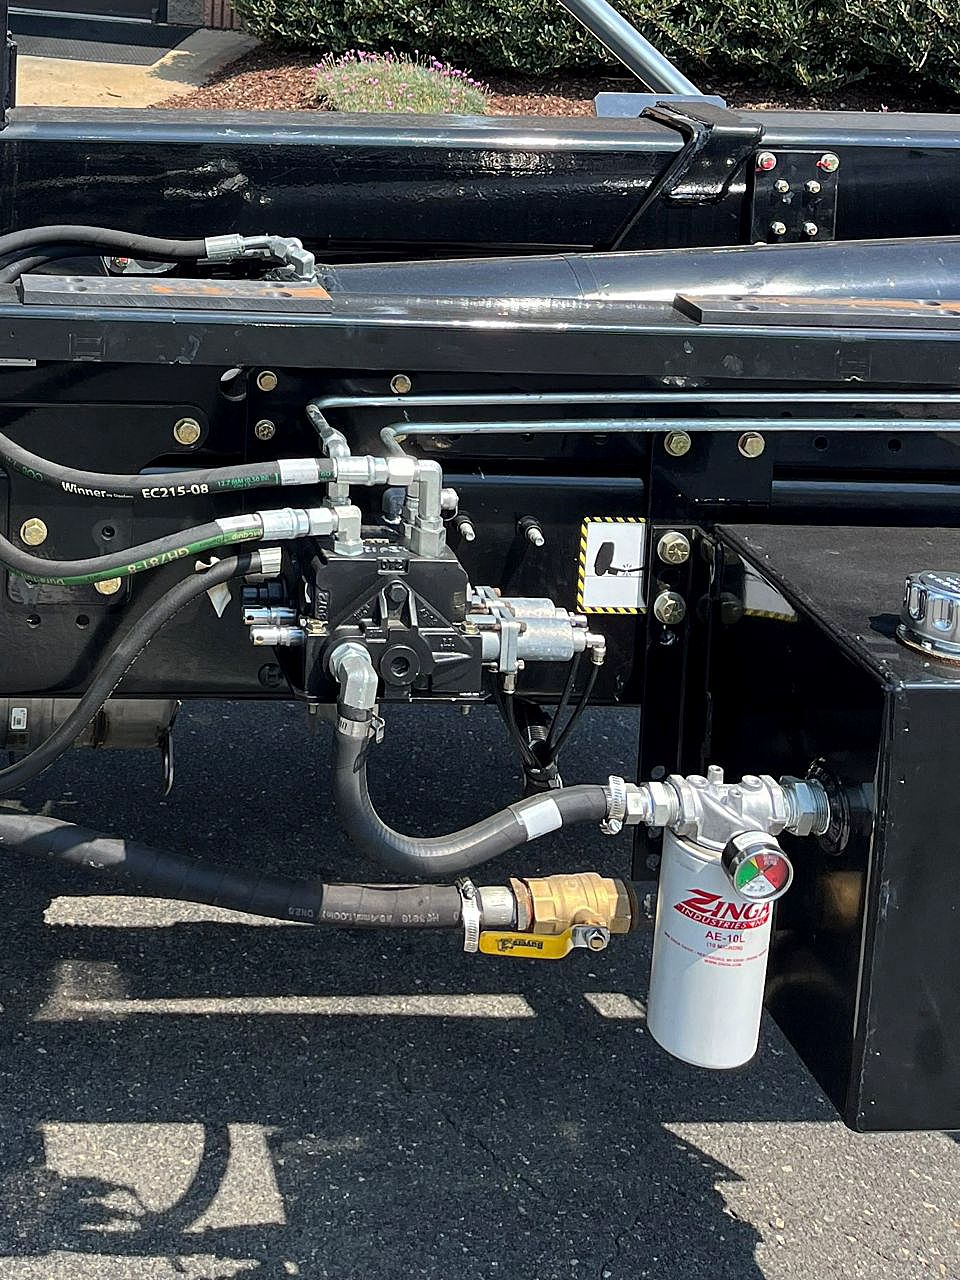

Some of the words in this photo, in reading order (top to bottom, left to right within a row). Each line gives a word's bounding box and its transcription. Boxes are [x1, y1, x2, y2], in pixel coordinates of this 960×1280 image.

[60, 480, 107, 499] Winner
[141, 483, 210, 500] EC215-08
[681, 888, 770, 921] ZINGA
[680, 906, 748, 930] INDUSTRIES
[704, 930, 746, 944] AE-10L
